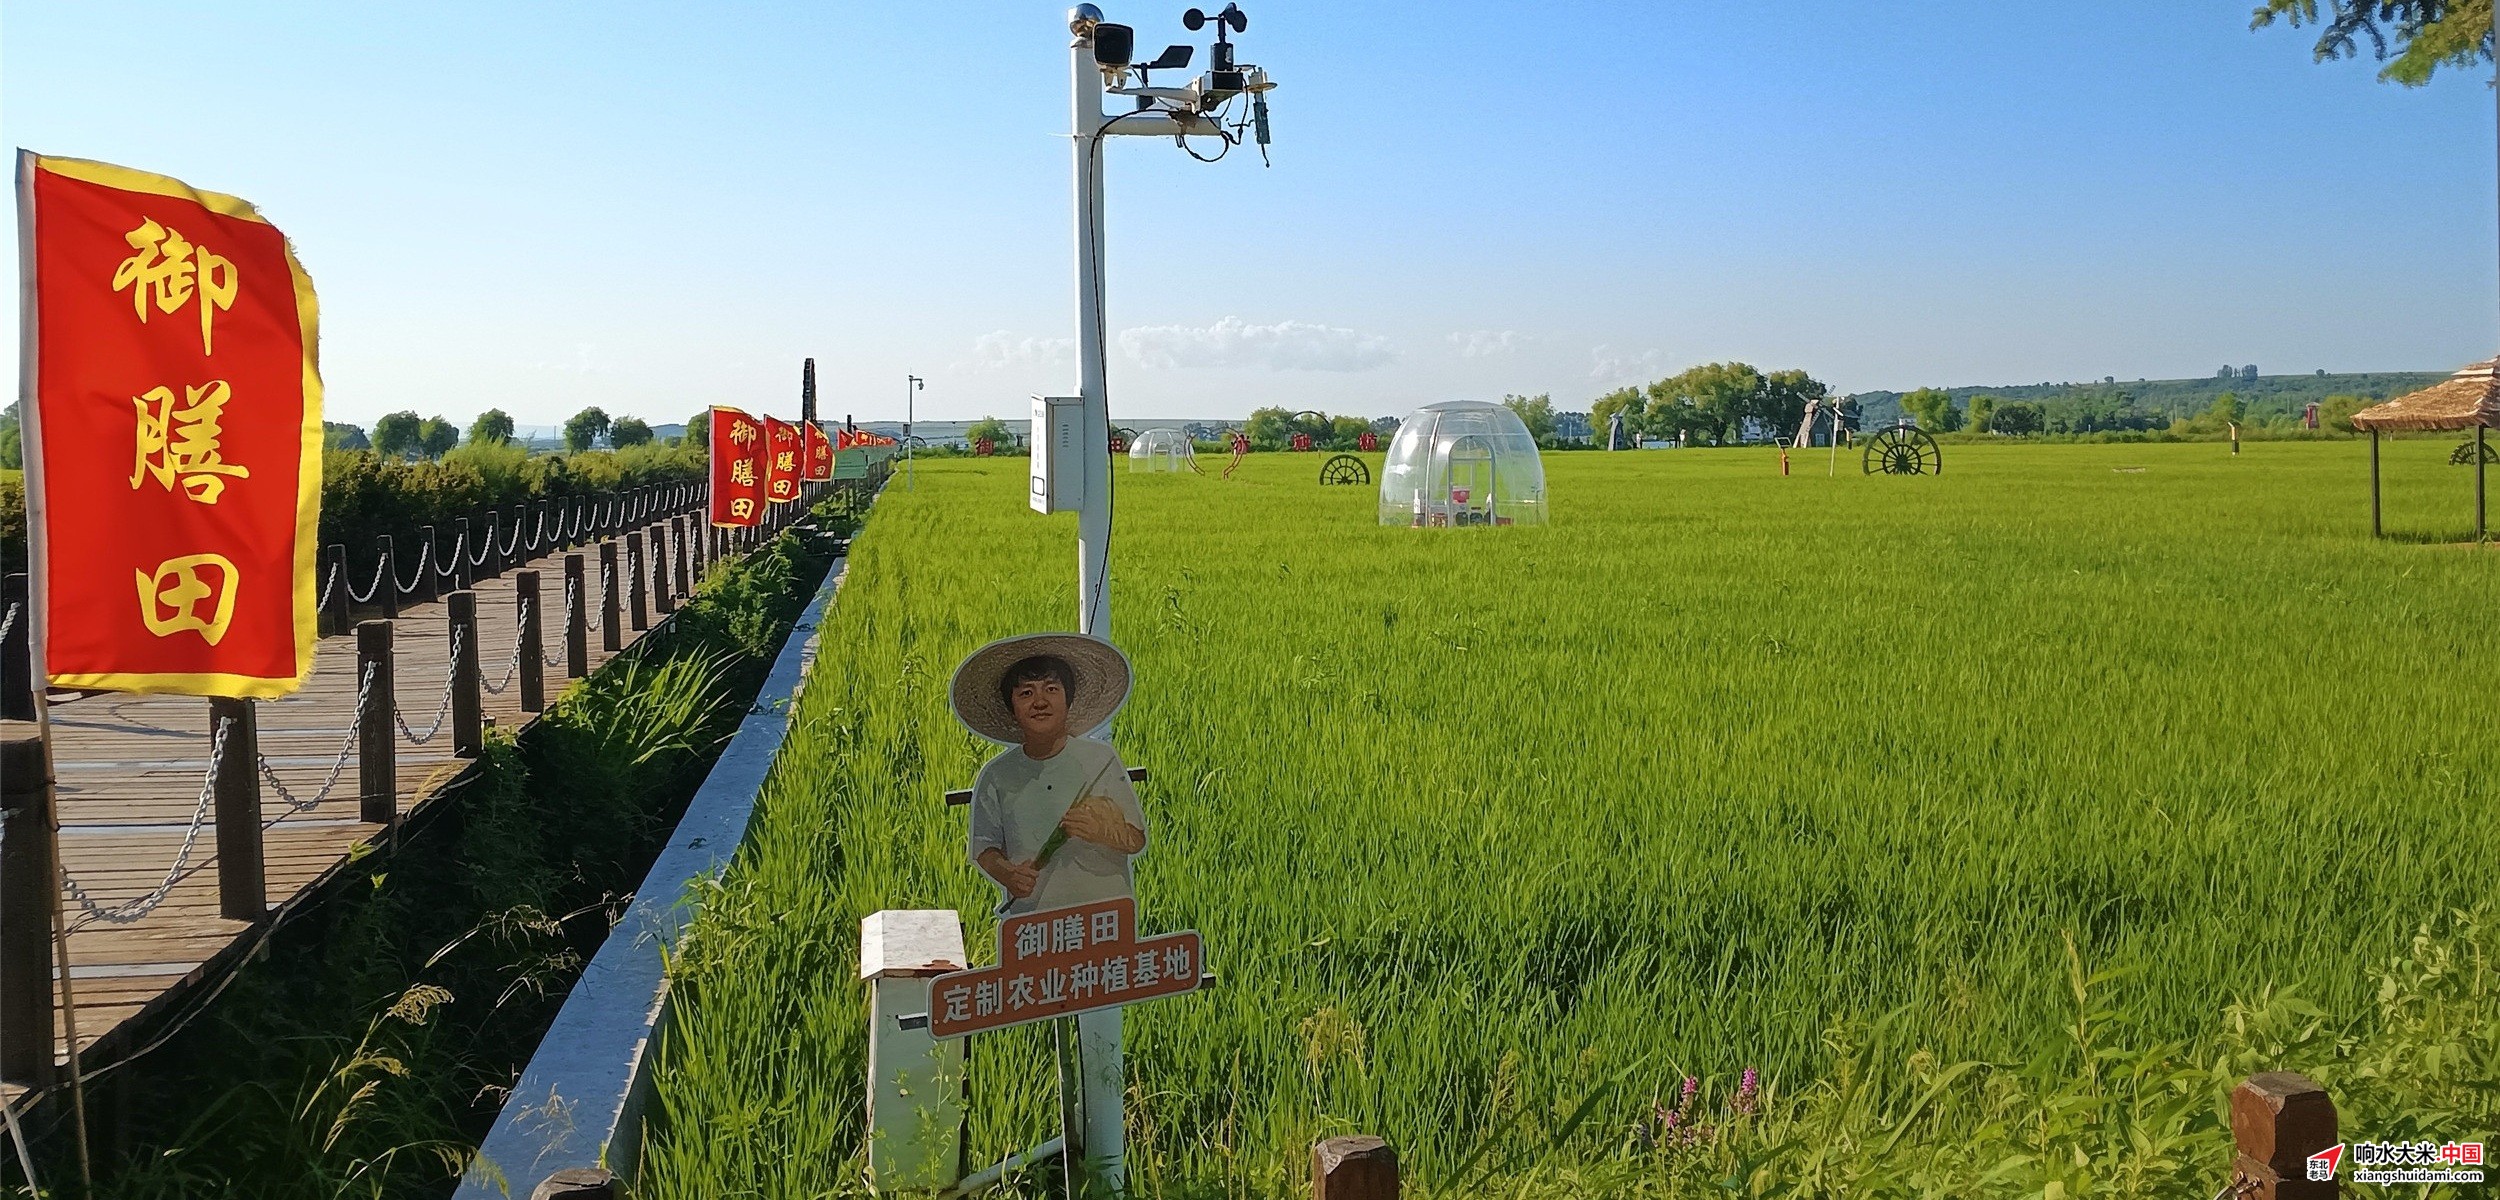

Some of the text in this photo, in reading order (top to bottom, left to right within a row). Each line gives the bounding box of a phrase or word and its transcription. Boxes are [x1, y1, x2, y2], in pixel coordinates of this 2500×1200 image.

[112, 214, 250, 647] 御膳田
[729, 418, 758, 521] 御膳田
[773, 426, 797, 496] 御膳田
[1014, 909, 1120, 961] 御膳田
[942, 943, 1192, 1024] 定制农业种植基地
